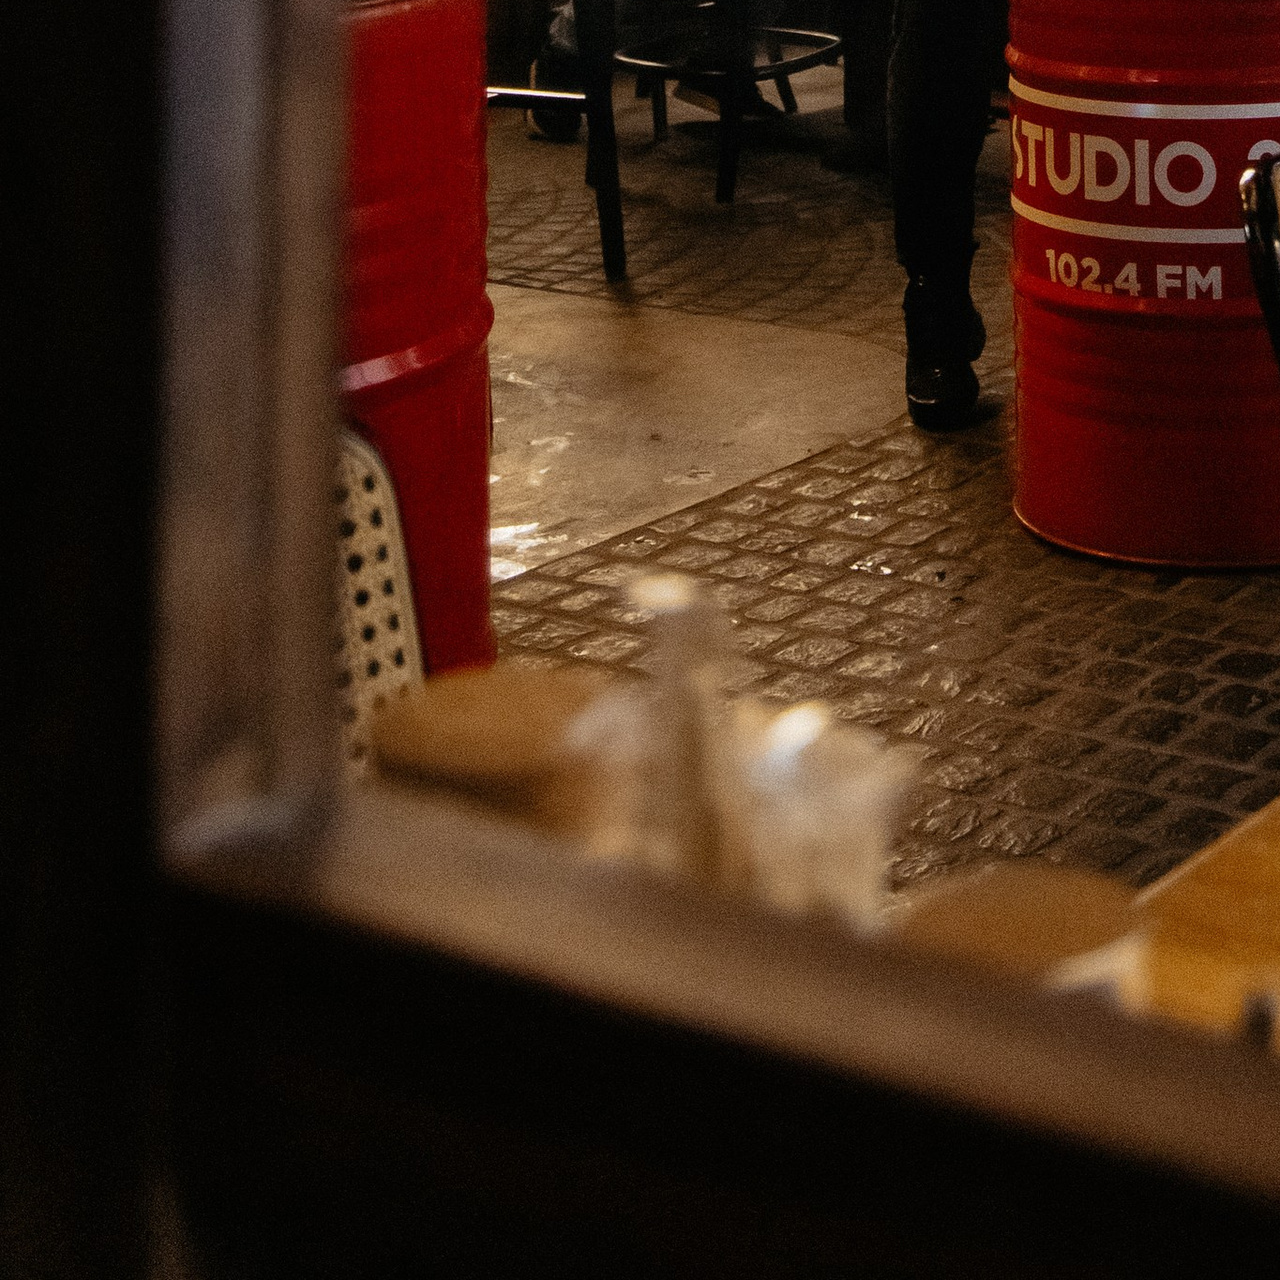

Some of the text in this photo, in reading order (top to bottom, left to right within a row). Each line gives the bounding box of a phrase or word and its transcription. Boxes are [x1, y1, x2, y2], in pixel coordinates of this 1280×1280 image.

[1012, 114, 1217, 207] STUDIO
[1045, 248, 1223, 300] 102.4 FM
